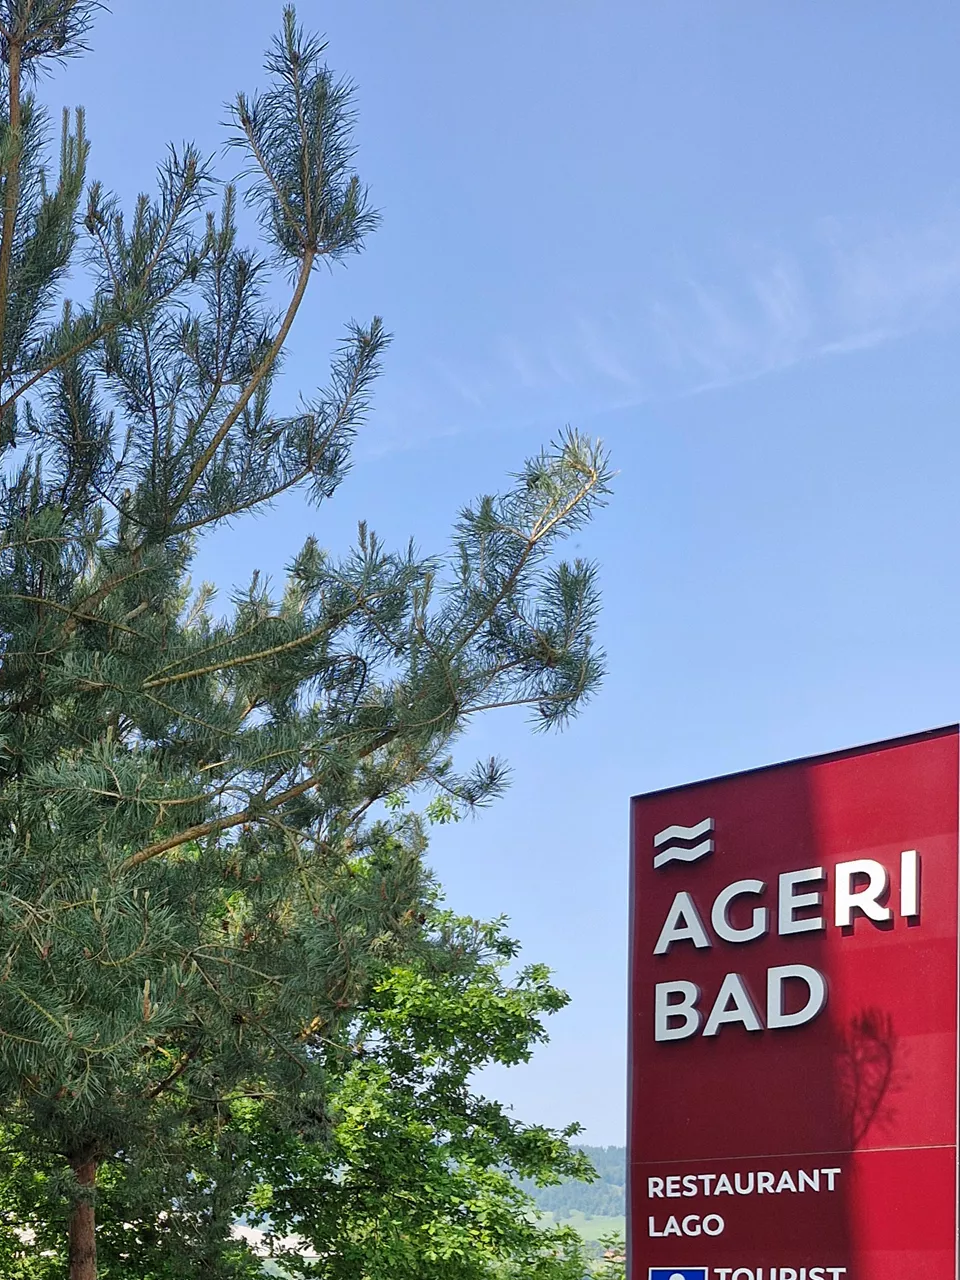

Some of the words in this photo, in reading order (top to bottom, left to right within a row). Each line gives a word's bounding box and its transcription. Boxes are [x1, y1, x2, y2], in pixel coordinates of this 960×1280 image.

[655, 964, 828, 1042] BAD
[647, 1168, 841, 1198] RESTAURANT
[648, 1213, 725, 1237] LAGO
